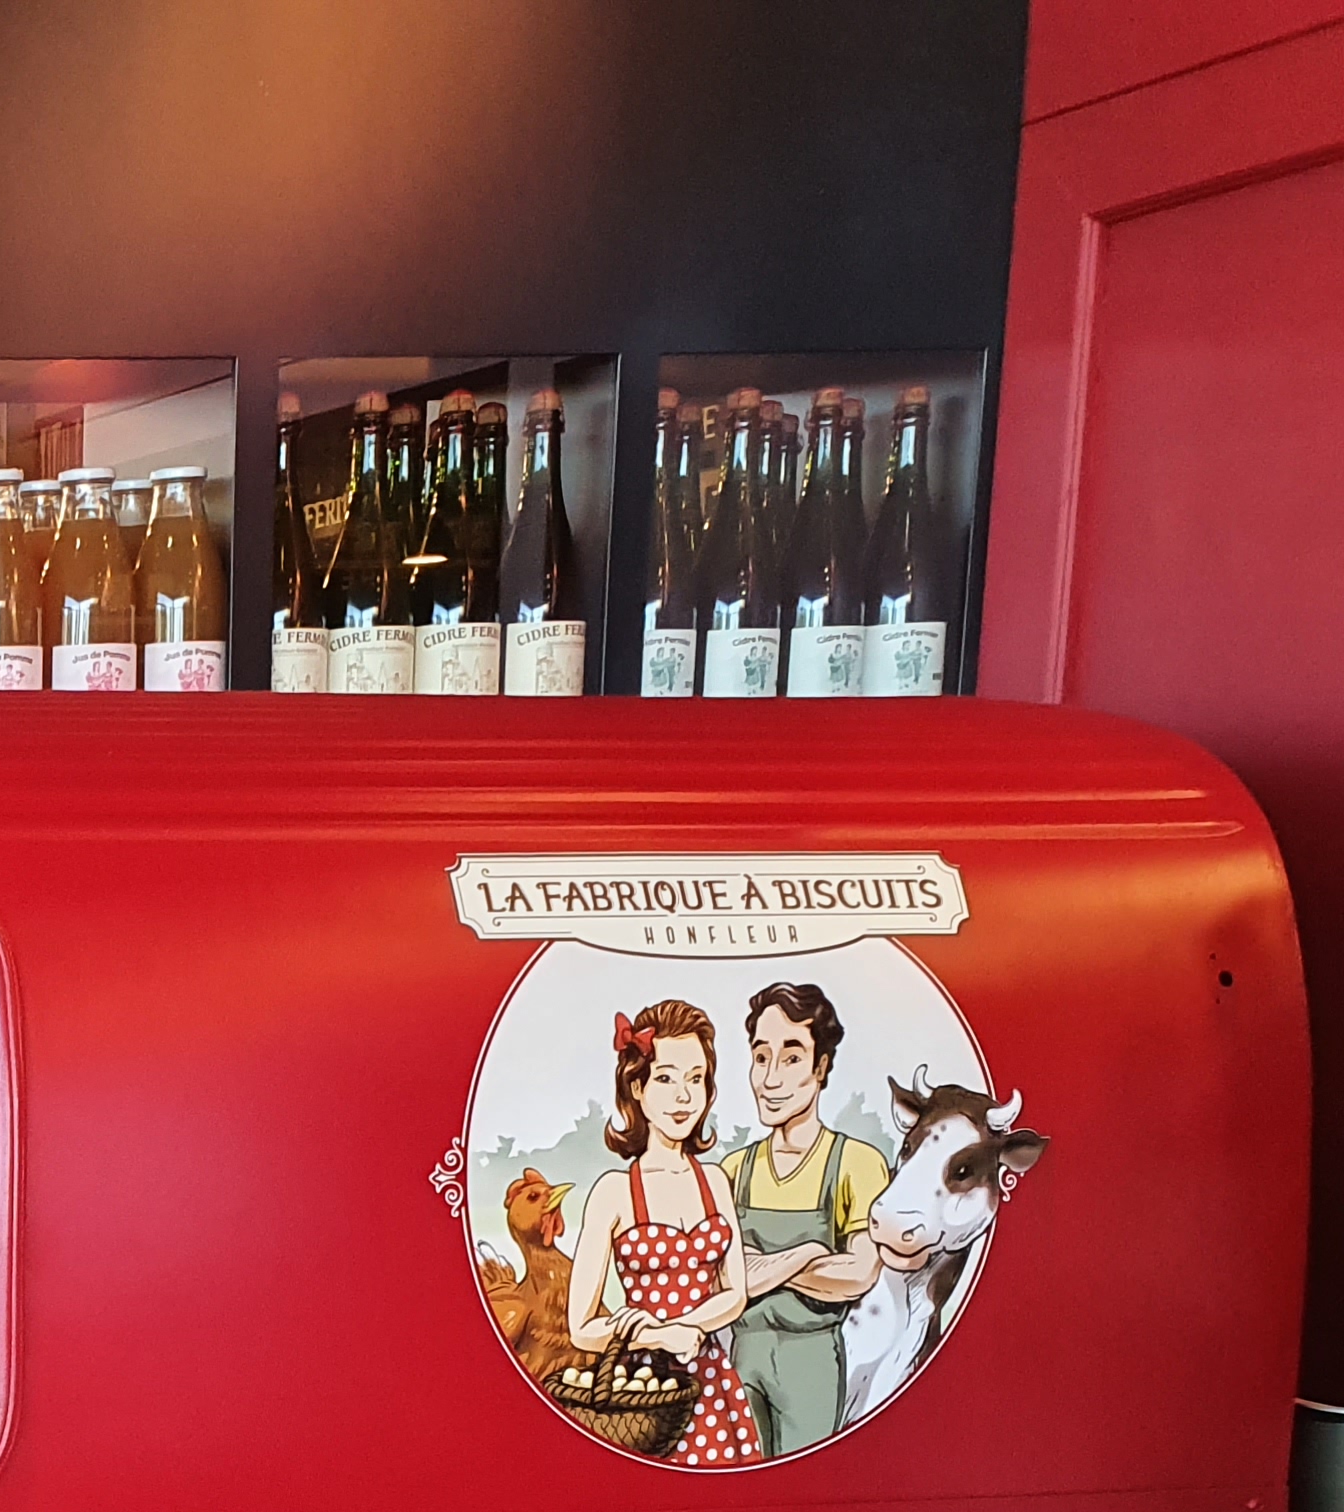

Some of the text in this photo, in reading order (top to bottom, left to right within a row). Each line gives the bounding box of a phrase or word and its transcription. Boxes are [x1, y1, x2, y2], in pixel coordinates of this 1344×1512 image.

[329, 629, 372, 653] CIDRE
[423, 626, 468, 650] CIDRE
[516, 626, 562, 647] CIDRE
[477, 873, 943, 916] LA FABRIQUE À BISCUITS
[643, 924, 800, 946] HONFLEUR
